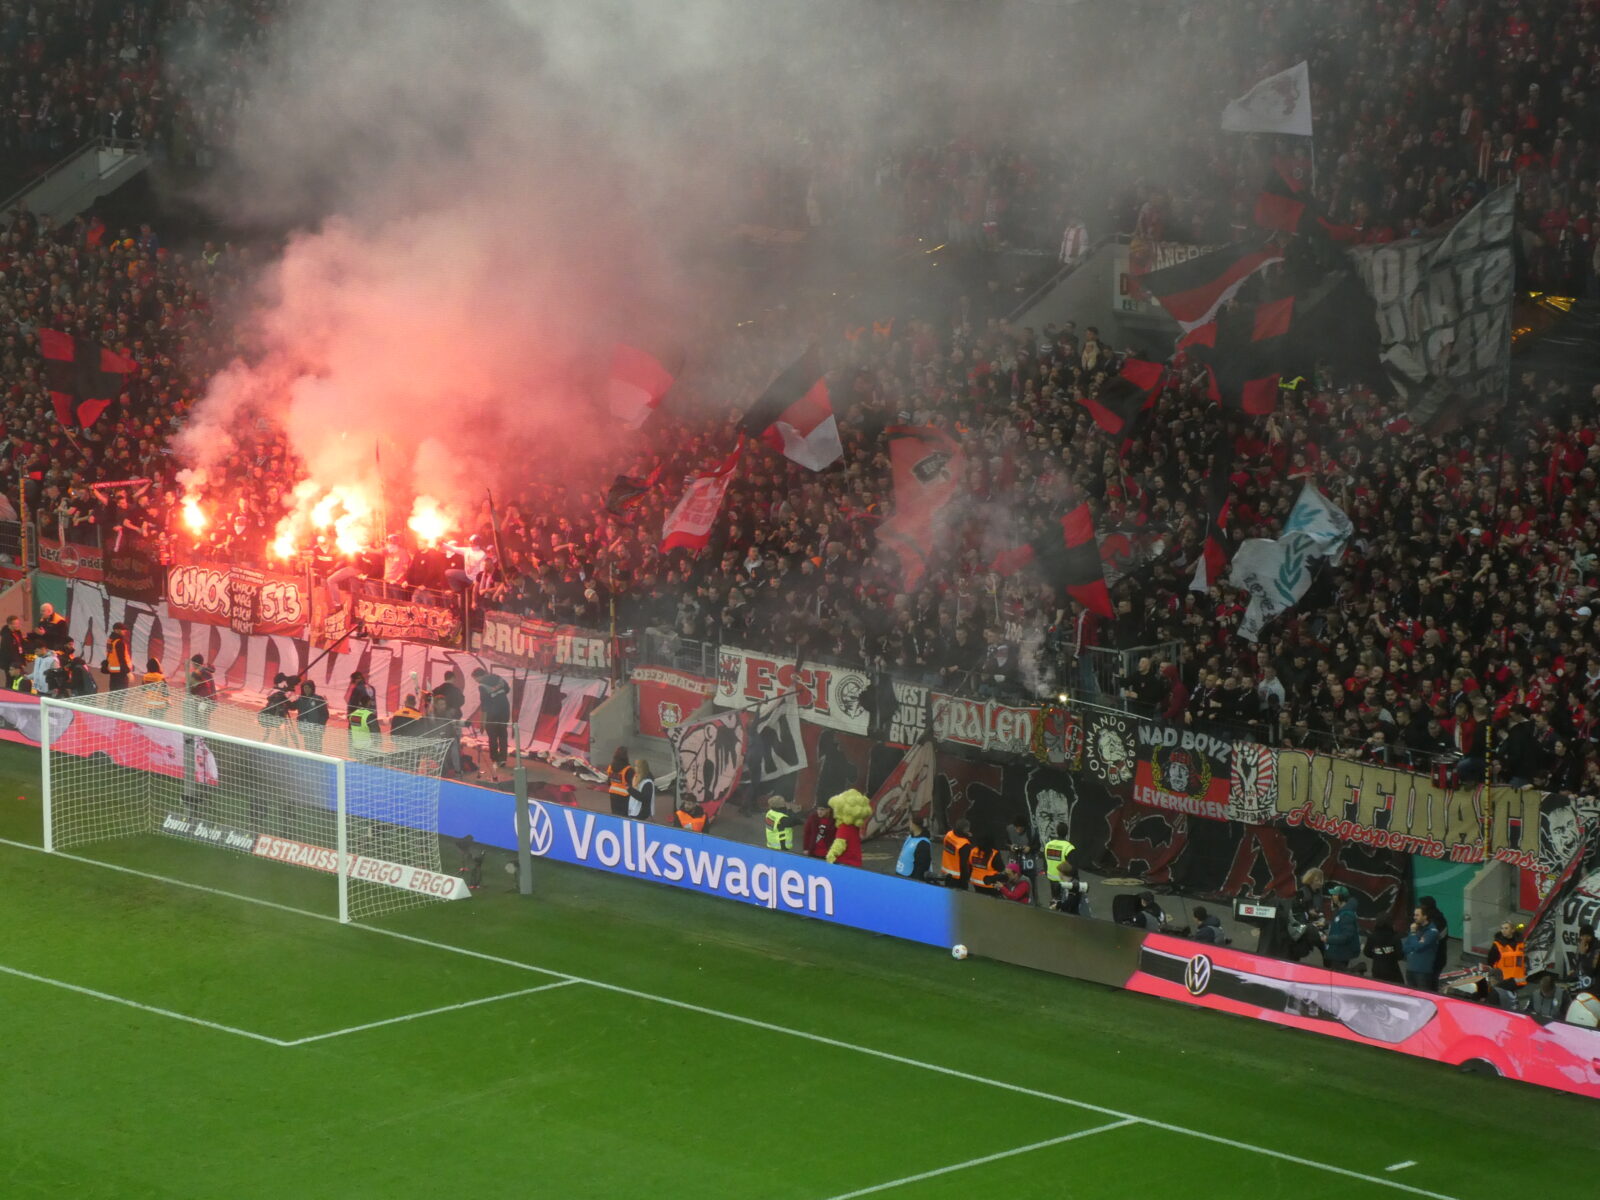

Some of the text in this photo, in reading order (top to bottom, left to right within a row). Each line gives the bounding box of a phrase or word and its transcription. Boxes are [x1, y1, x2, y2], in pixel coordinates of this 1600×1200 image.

[168, 565, 231, 617] CHAOS
[260, 581, 302, 623] 513
[892, 681, 929, 707] WEST
[1086, 716, 1126, 780] COMMANDO
[1125, 734, 1136, 768] 1989
[1180, 730, 1233, 766] BOYZ
[1134, 785, 1231, 819] LEVERKUSEN
[1276, 751, 1542, 857] DIFFIDATI
[226, 830, 252, 849] bwin
[1287, 801, 1446, 861] Ausgesperrte
[270, 840, 456, 896] STRAUSS ERGO ERGO
[564, 809, 834, 916] Volkswagen
